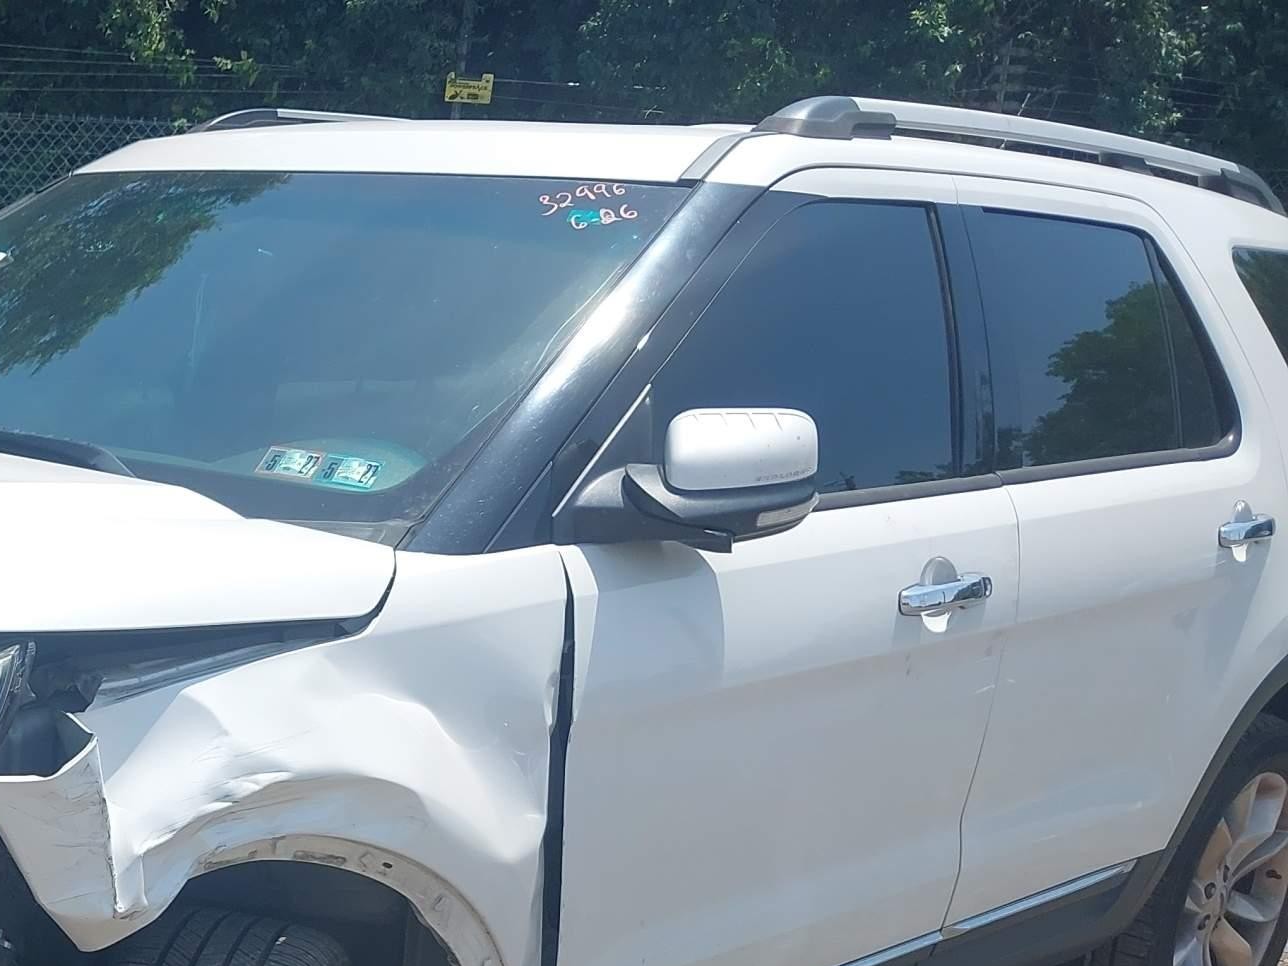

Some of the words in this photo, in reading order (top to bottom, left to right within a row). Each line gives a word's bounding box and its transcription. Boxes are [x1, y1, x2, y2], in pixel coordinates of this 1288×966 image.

[539, 183, 626, 216] 32996
[297, 455, 321, 477] 27
[358, 463, 379, 485] 27
